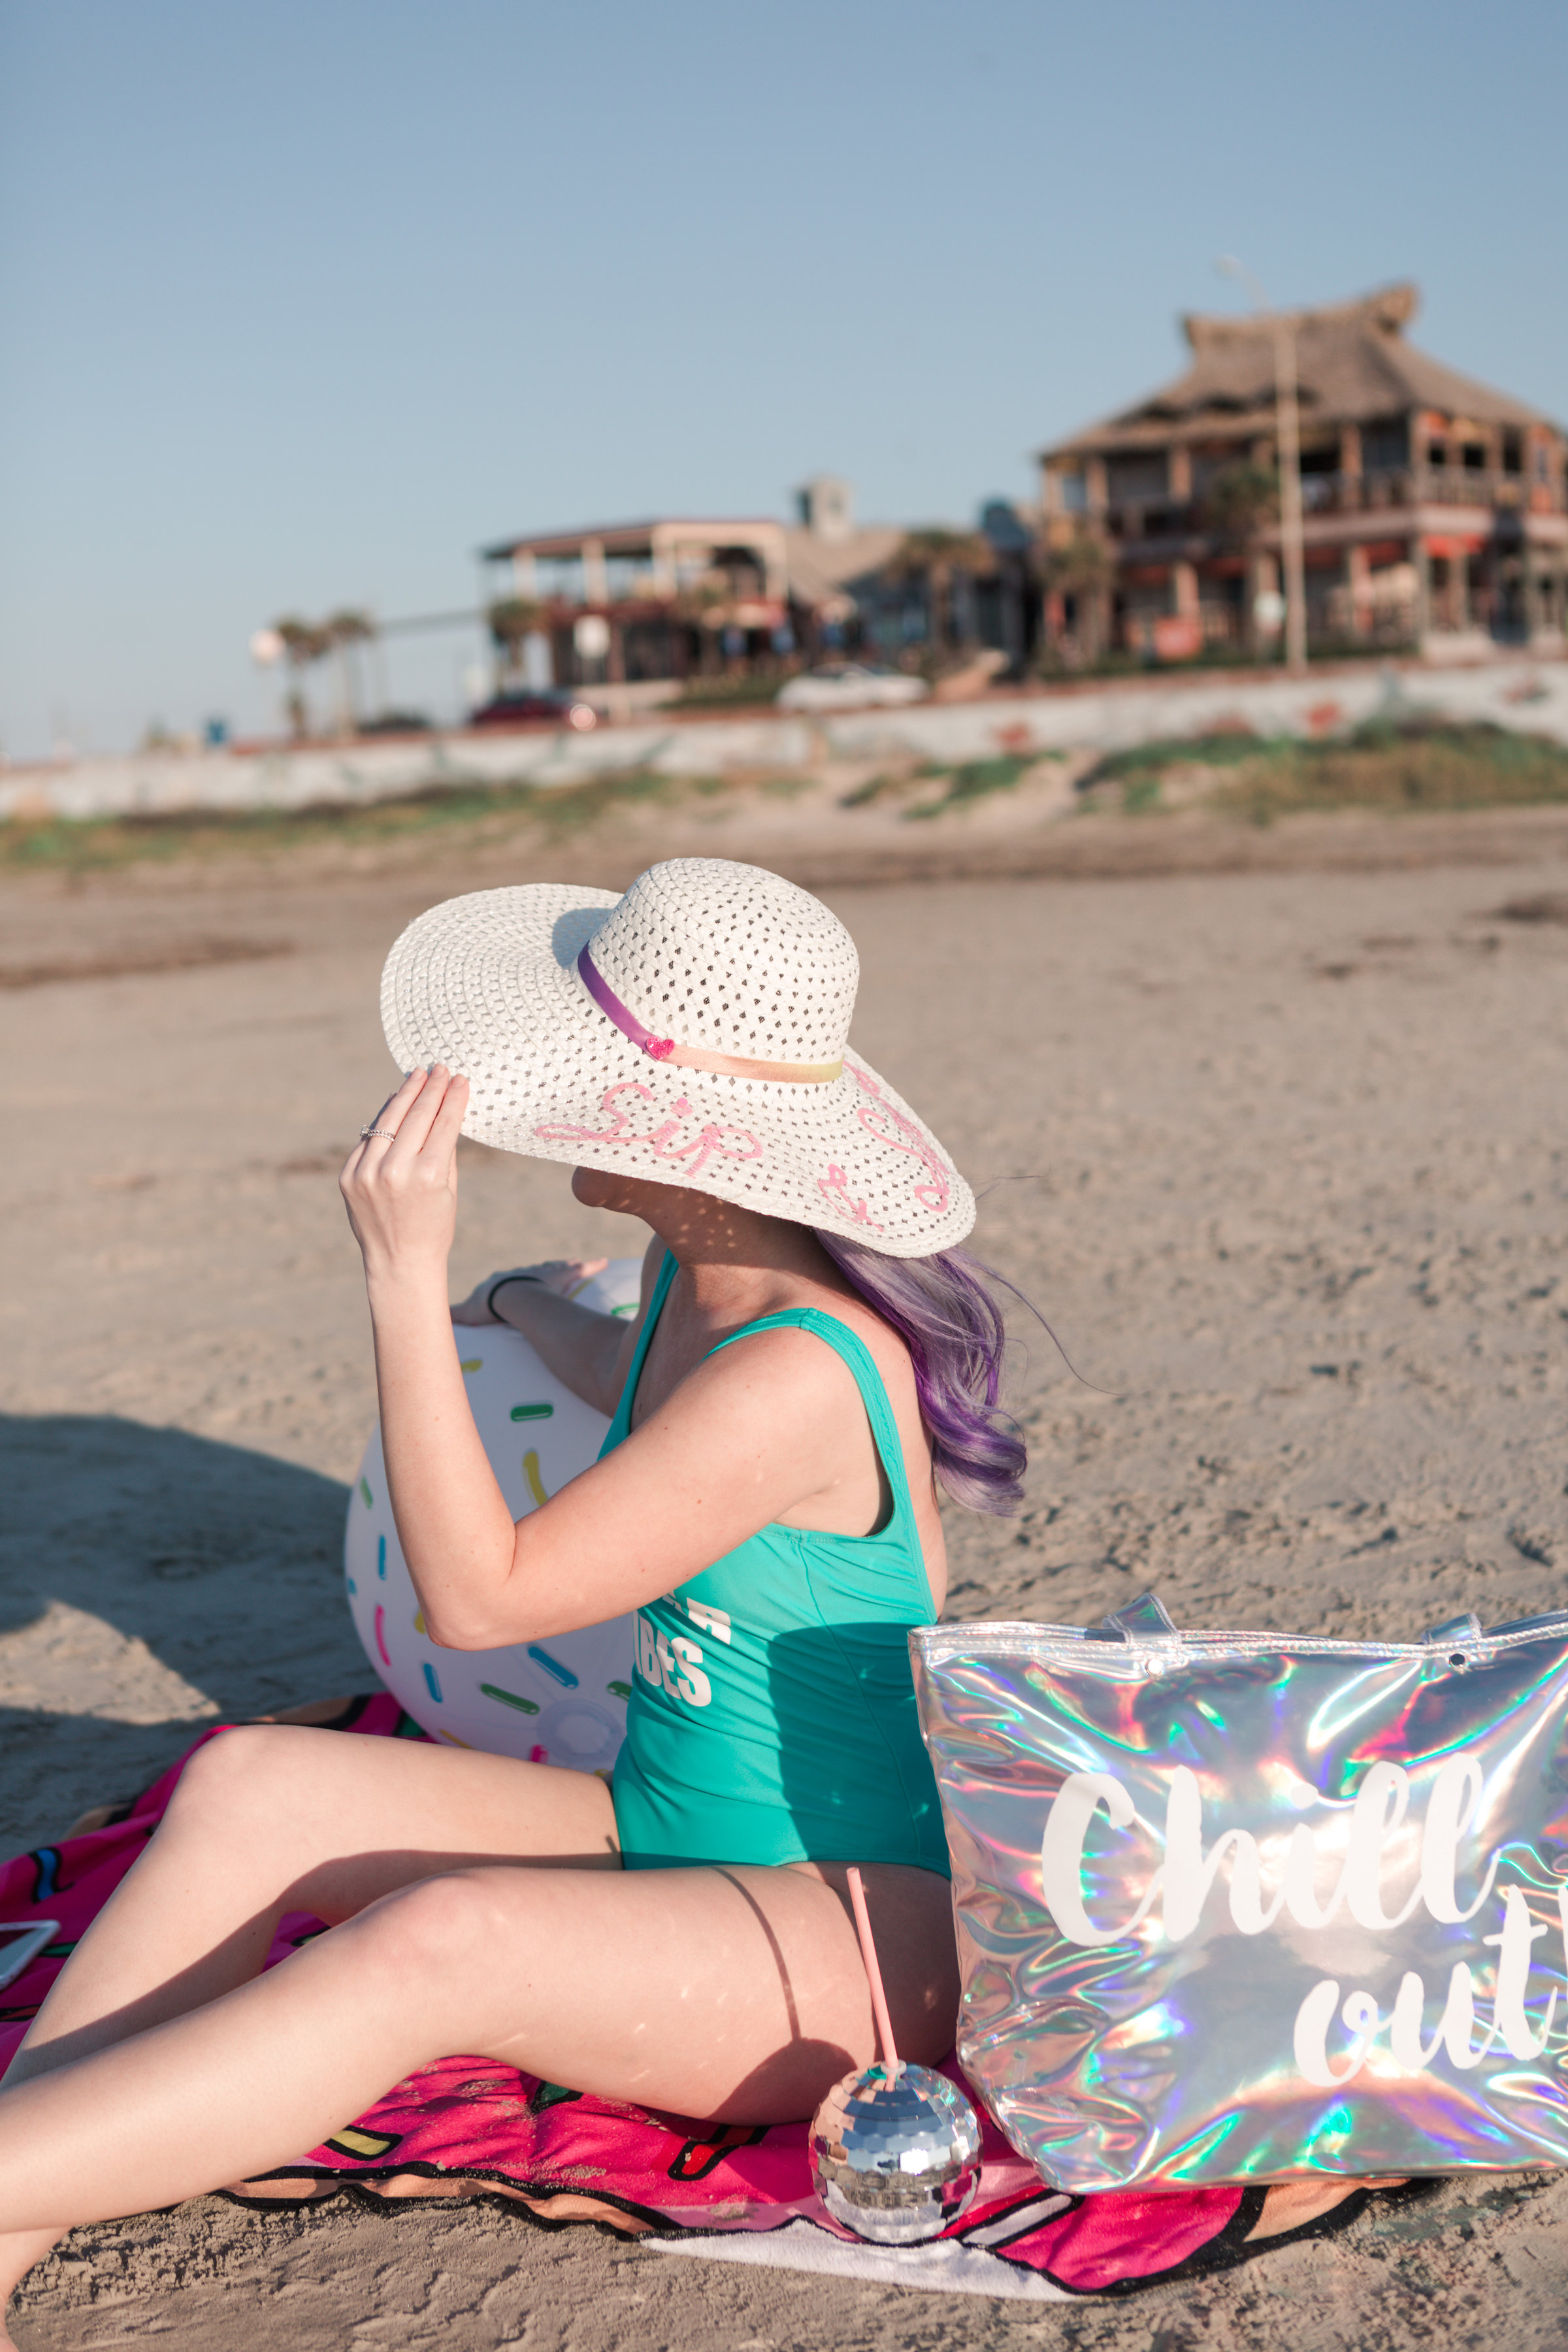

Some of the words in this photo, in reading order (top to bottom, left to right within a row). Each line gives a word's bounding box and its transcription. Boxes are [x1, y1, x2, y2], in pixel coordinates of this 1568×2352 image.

[533, 1081, 764, 1179] Sip
[632, 1609, 712, 1707] IBES
[1041, 1752, 1501, 1947] Chill
